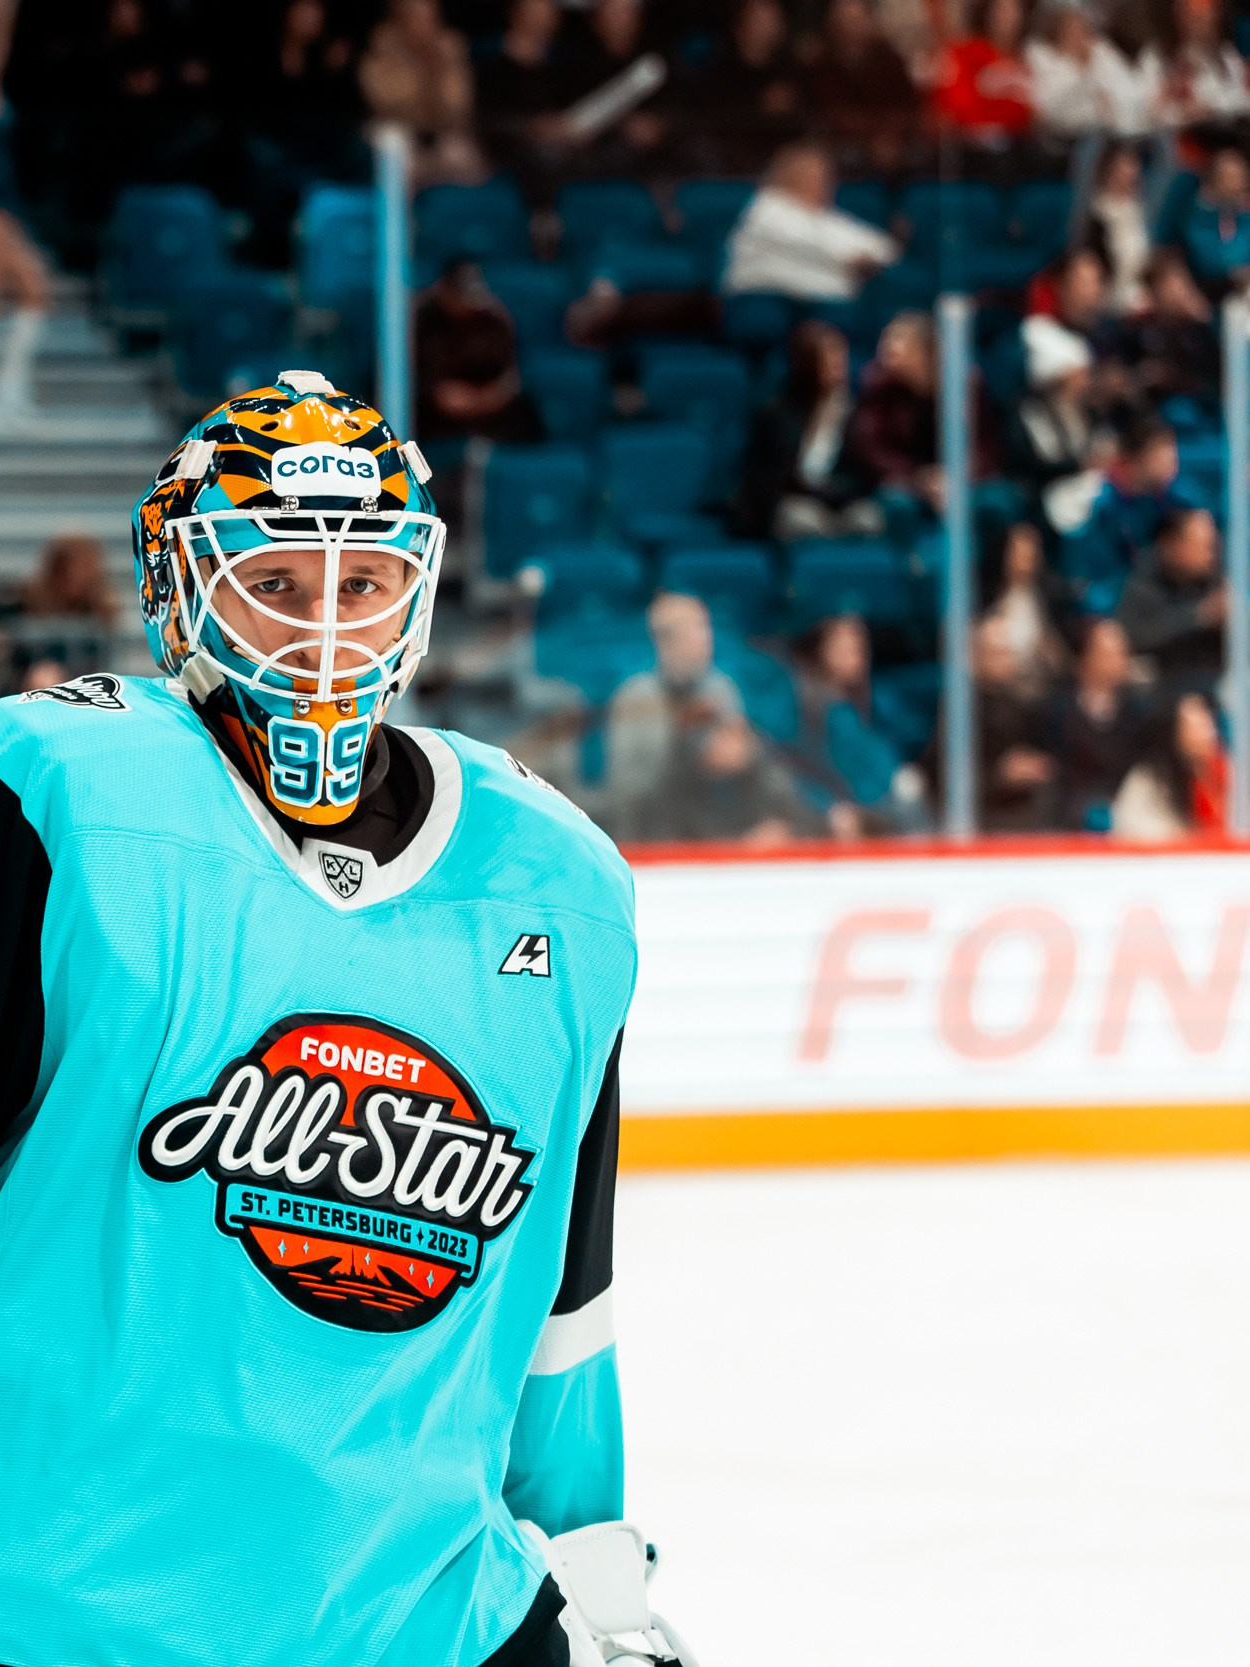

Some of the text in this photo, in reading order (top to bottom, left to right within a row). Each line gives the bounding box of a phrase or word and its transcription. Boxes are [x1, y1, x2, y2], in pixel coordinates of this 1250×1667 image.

[268, 716, 371, 808] 99
[796, 904, 1250, 1062] FON
[300, 1036, 426, 1084] FONBET
[152, 1065, 523, 1227] All-Star
[240, 1191, 469, 1258] ST. PETERSBURG 2023
